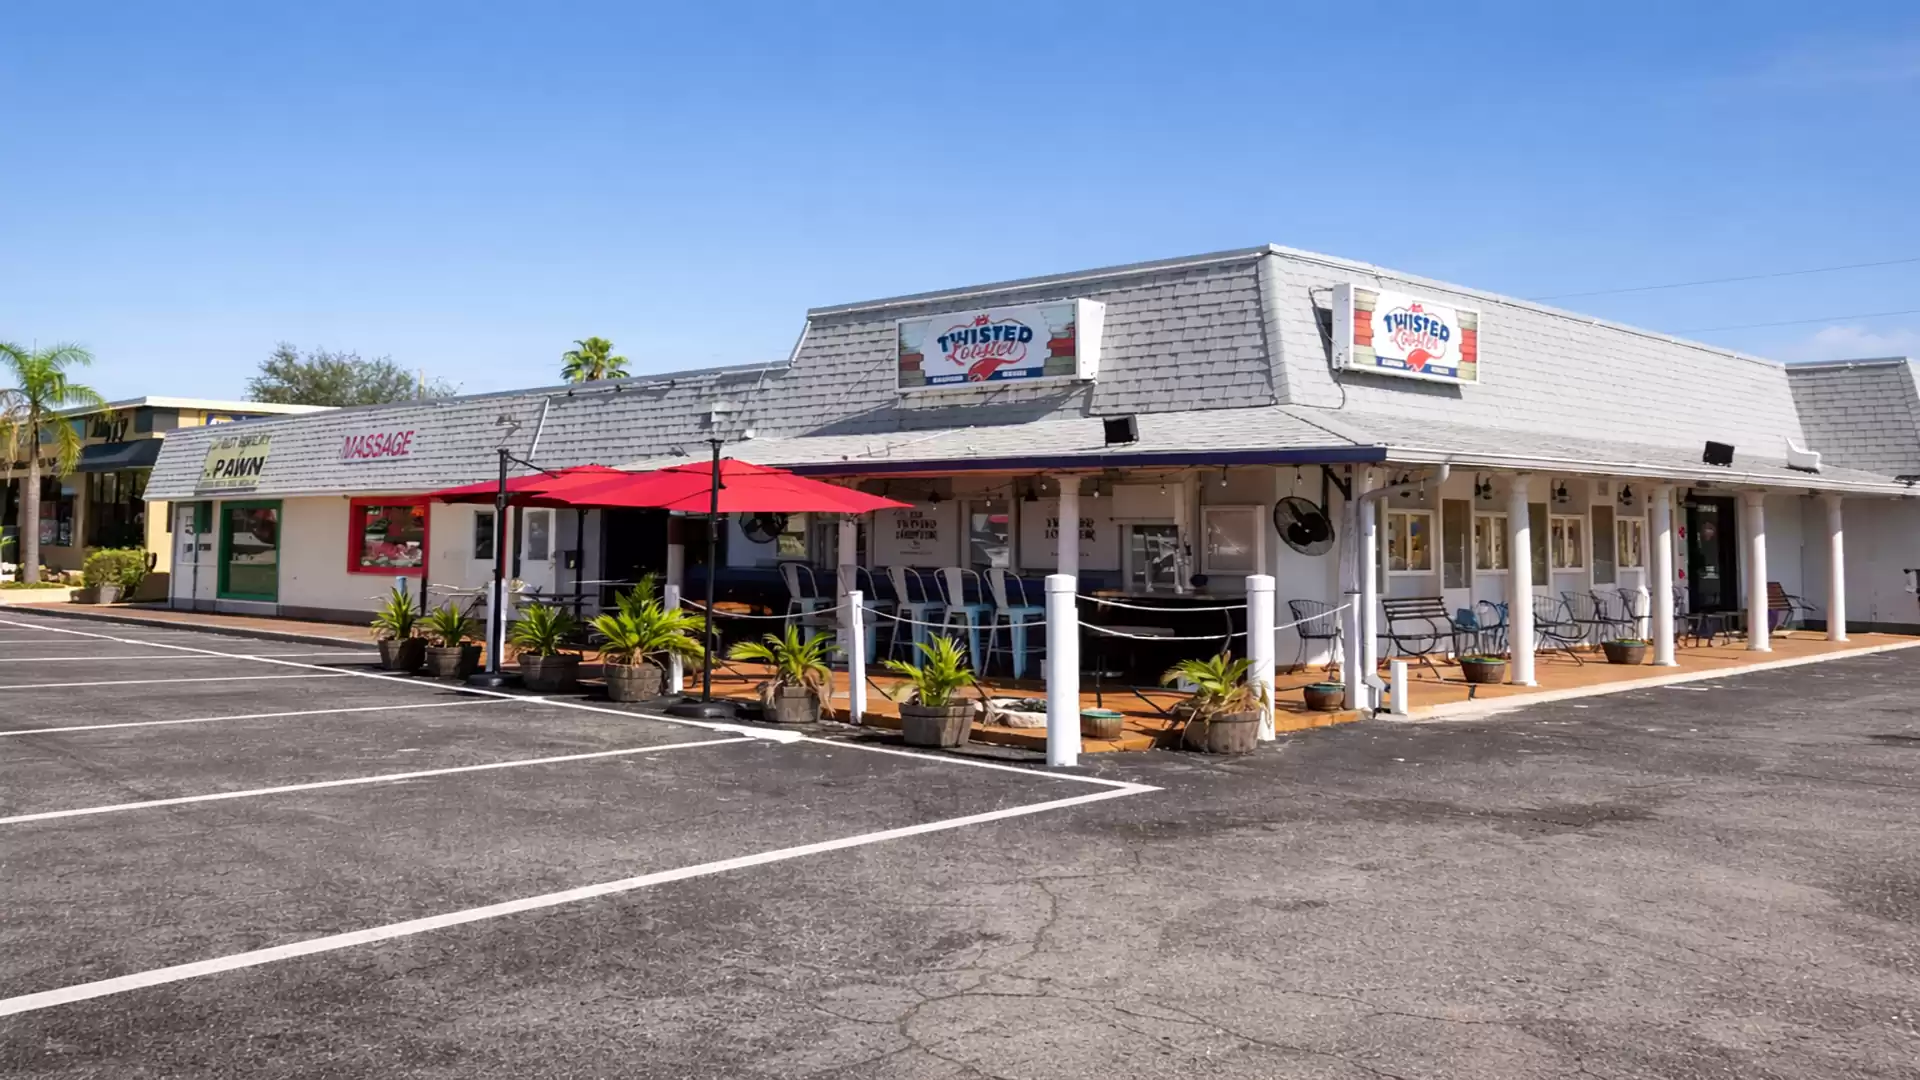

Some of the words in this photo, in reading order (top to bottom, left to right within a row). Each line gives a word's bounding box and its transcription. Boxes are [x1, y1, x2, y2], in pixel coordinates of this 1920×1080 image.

[937, 325, 1032, 353] TWISTED
[1383, 313, 1450, 342] TWISTED
[342, 430, 415, 459] MASSAGE
[213, 456, 264, 478] PAWN
